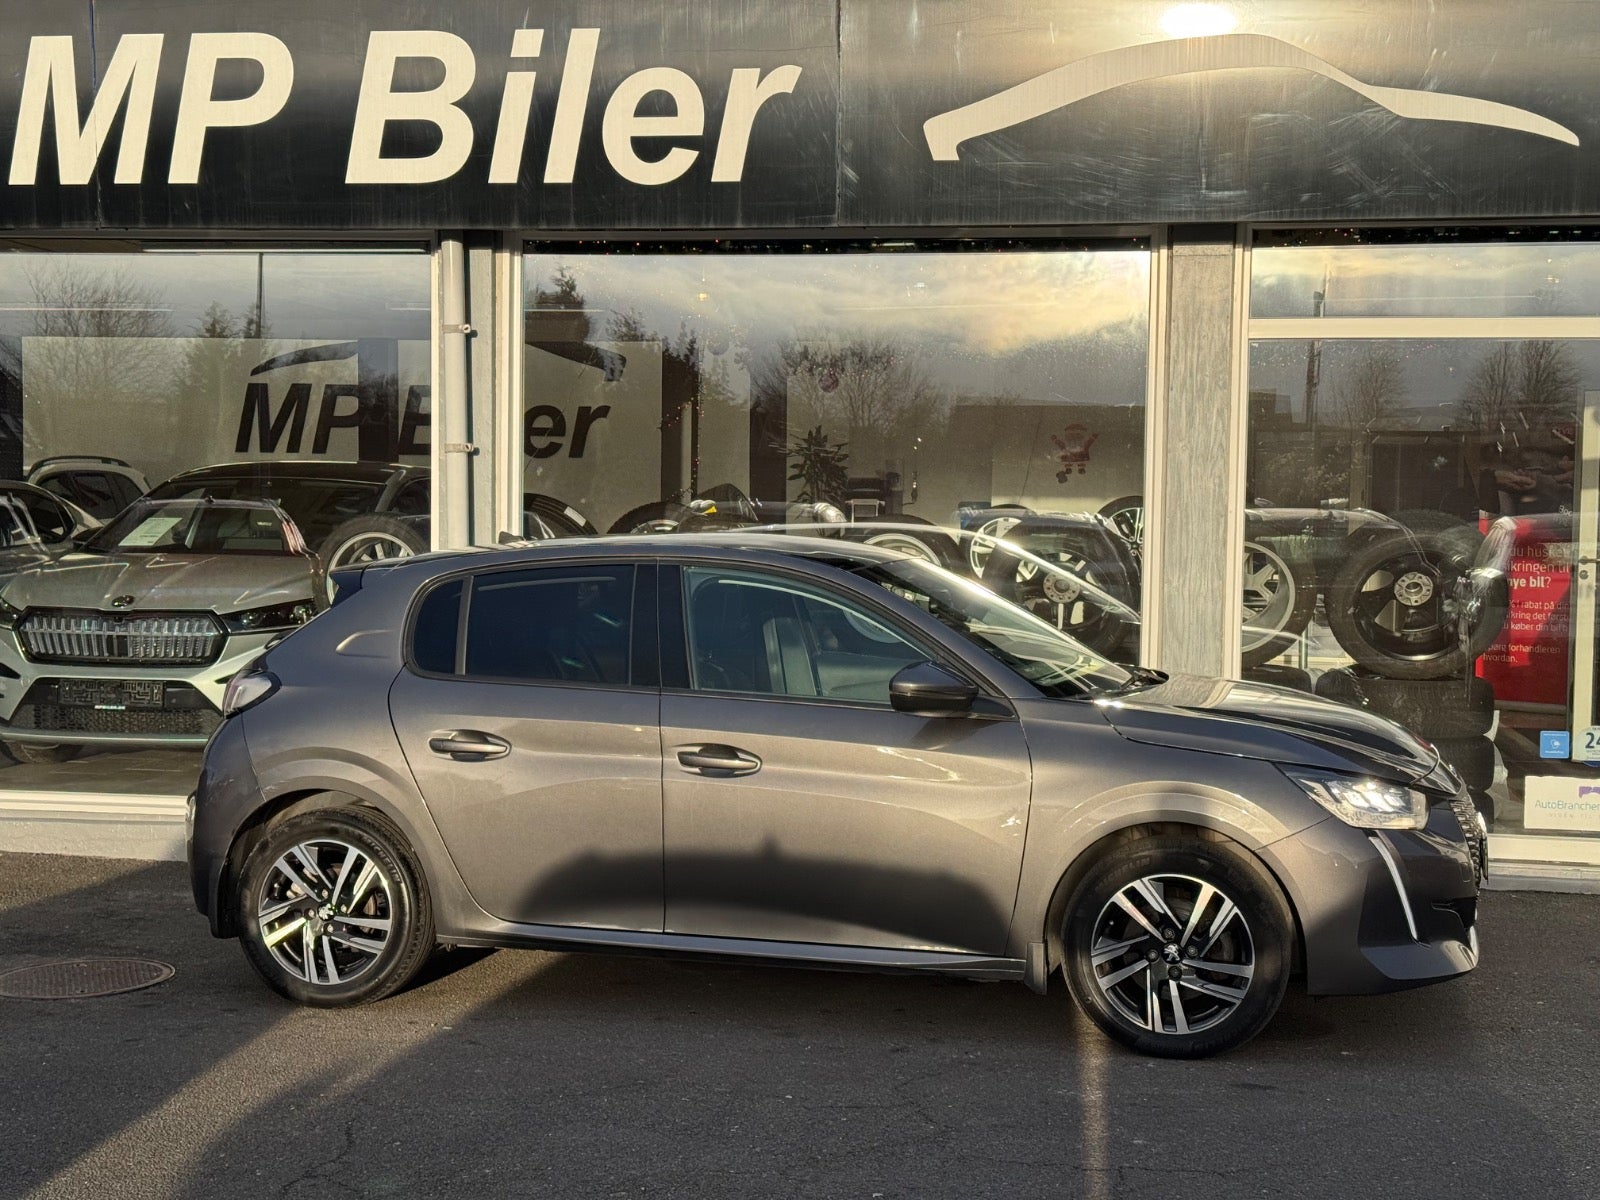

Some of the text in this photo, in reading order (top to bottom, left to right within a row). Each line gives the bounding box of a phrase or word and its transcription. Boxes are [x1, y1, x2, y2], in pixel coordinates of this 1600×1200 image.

[8, 27, 803, 186] MP Biler
[234, 382, 362, 454] MP
[1507, 560, 1554, 575] ikringen
[1530, 576, 1551, 588] bil?
